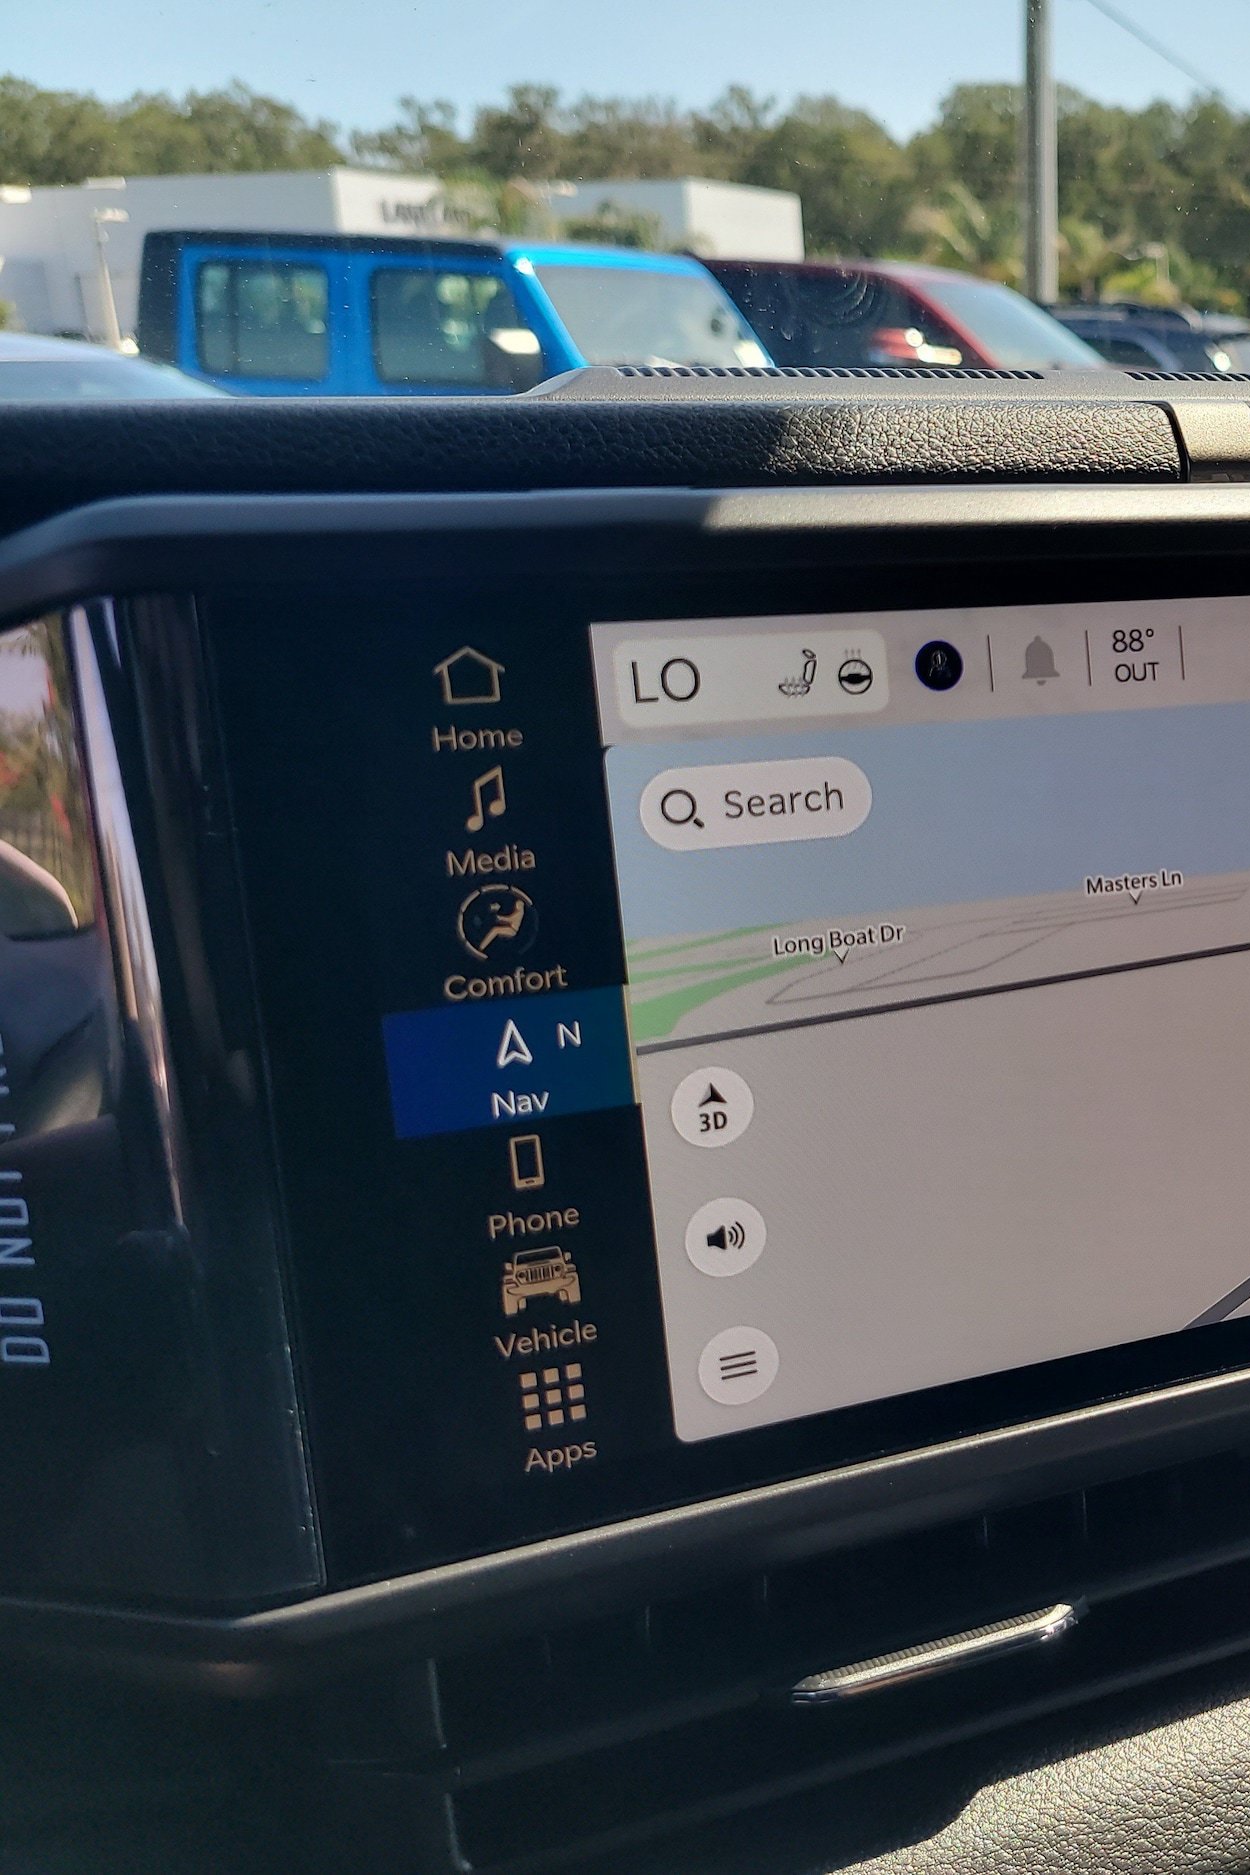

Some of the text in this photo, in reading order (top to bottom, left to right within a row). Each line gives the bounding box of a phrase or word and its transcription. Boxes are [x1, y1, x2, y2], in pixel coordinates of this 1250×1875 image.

[1112, 627, 1154, 653] 88°
[630, 658, 700, 703] LO
[1114, 662, 1160, 682] OUT
[432, 725, 524, 752] Home
[723, 781, 845, 820] Search
[446, 845, 537, 876] Media
[1086, 869, 1182, 896] Masters Ln
[773, 923, 907, 956] Long Boat Dr
[444, 964, 569, 1001] Comfort
[557, 1020, 581, 1049] N
[490, 1090, 551, 1120] Nav
[699, 1111, 728, 1133] 3D
[487, 1205, 580, 1240] Phone
[493, 1319, 598, 1359] Vehicle
[523, 1437, 598, 1473] Apps
